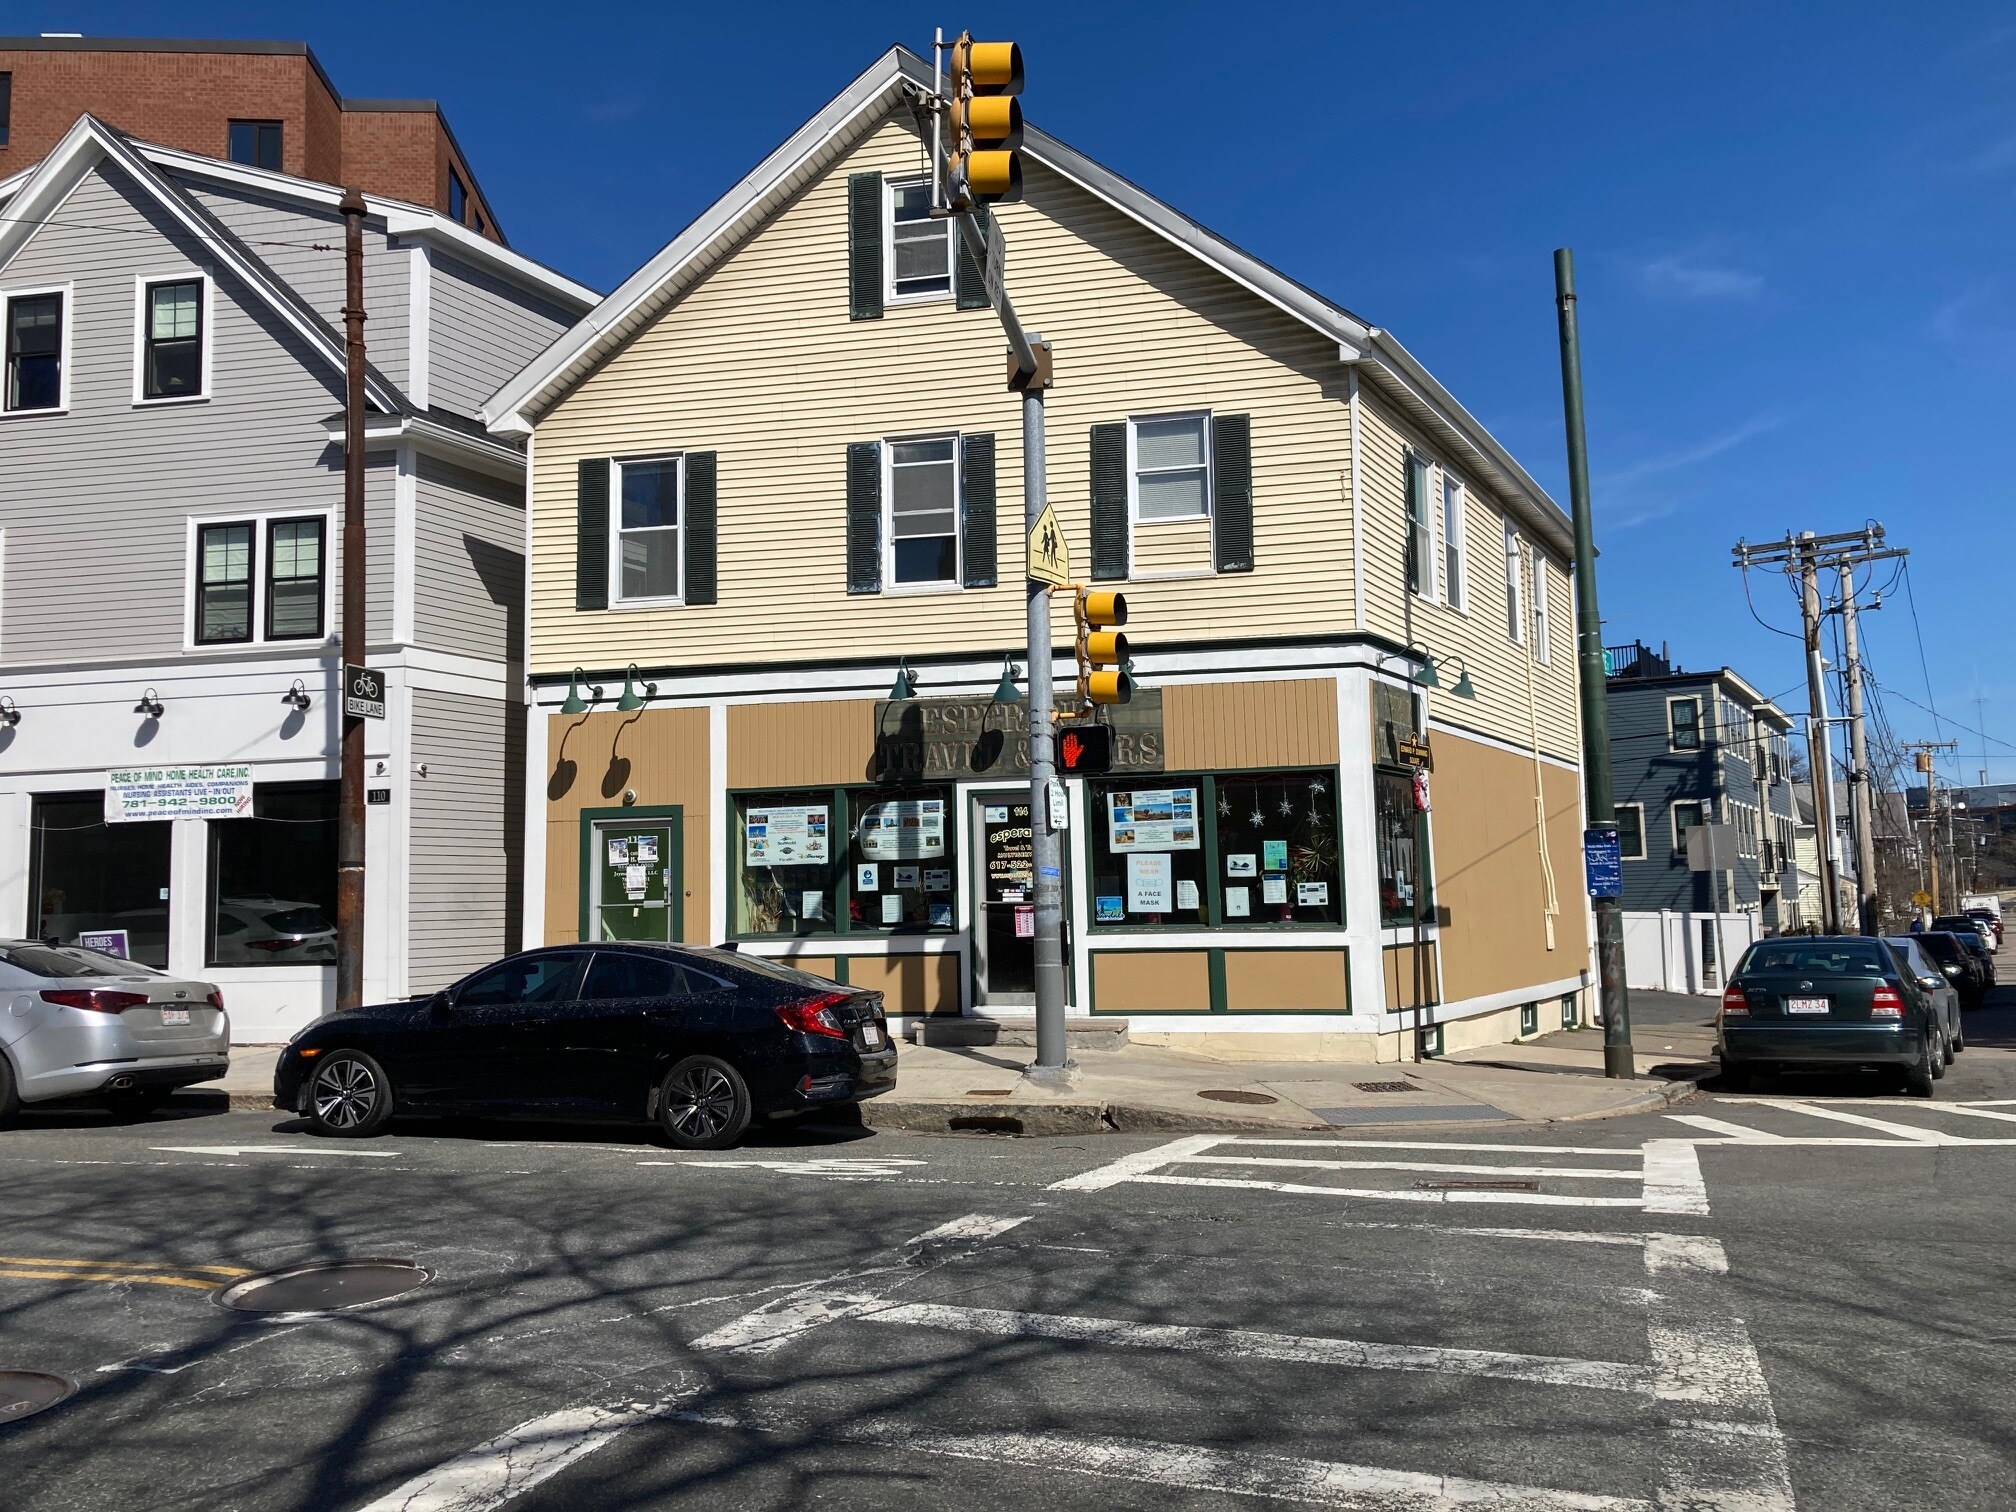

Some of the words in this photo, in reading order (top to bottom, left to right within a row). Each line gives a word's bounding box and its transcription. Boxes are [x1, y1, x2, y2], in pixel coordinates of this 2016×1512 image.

[349, 699, 364, 712] BIKE
[366, 701, 383, 715] LANE
[110, 773, 132, 784] PEACE
[133, 772, 142, 782] OF
[144, 771, 163, 781] MIND
[165, 769, 186, 780] HOME
[188, 768, 214, 779] HEALTH
[123, 790, 152, 799] NURSING
[154, 789, 192, 798] ASSISTANTS
[372, 790, 386, 802] 110
[122, 796, 237, 808] 781-942-9800
[125, 808, 233, 818] www.peaceofmindinc.com
[990, 828, 1032, 843] espera
[990, 860, 1032, 869] 617-522-
[84, 936, 113, 948] HEROES
